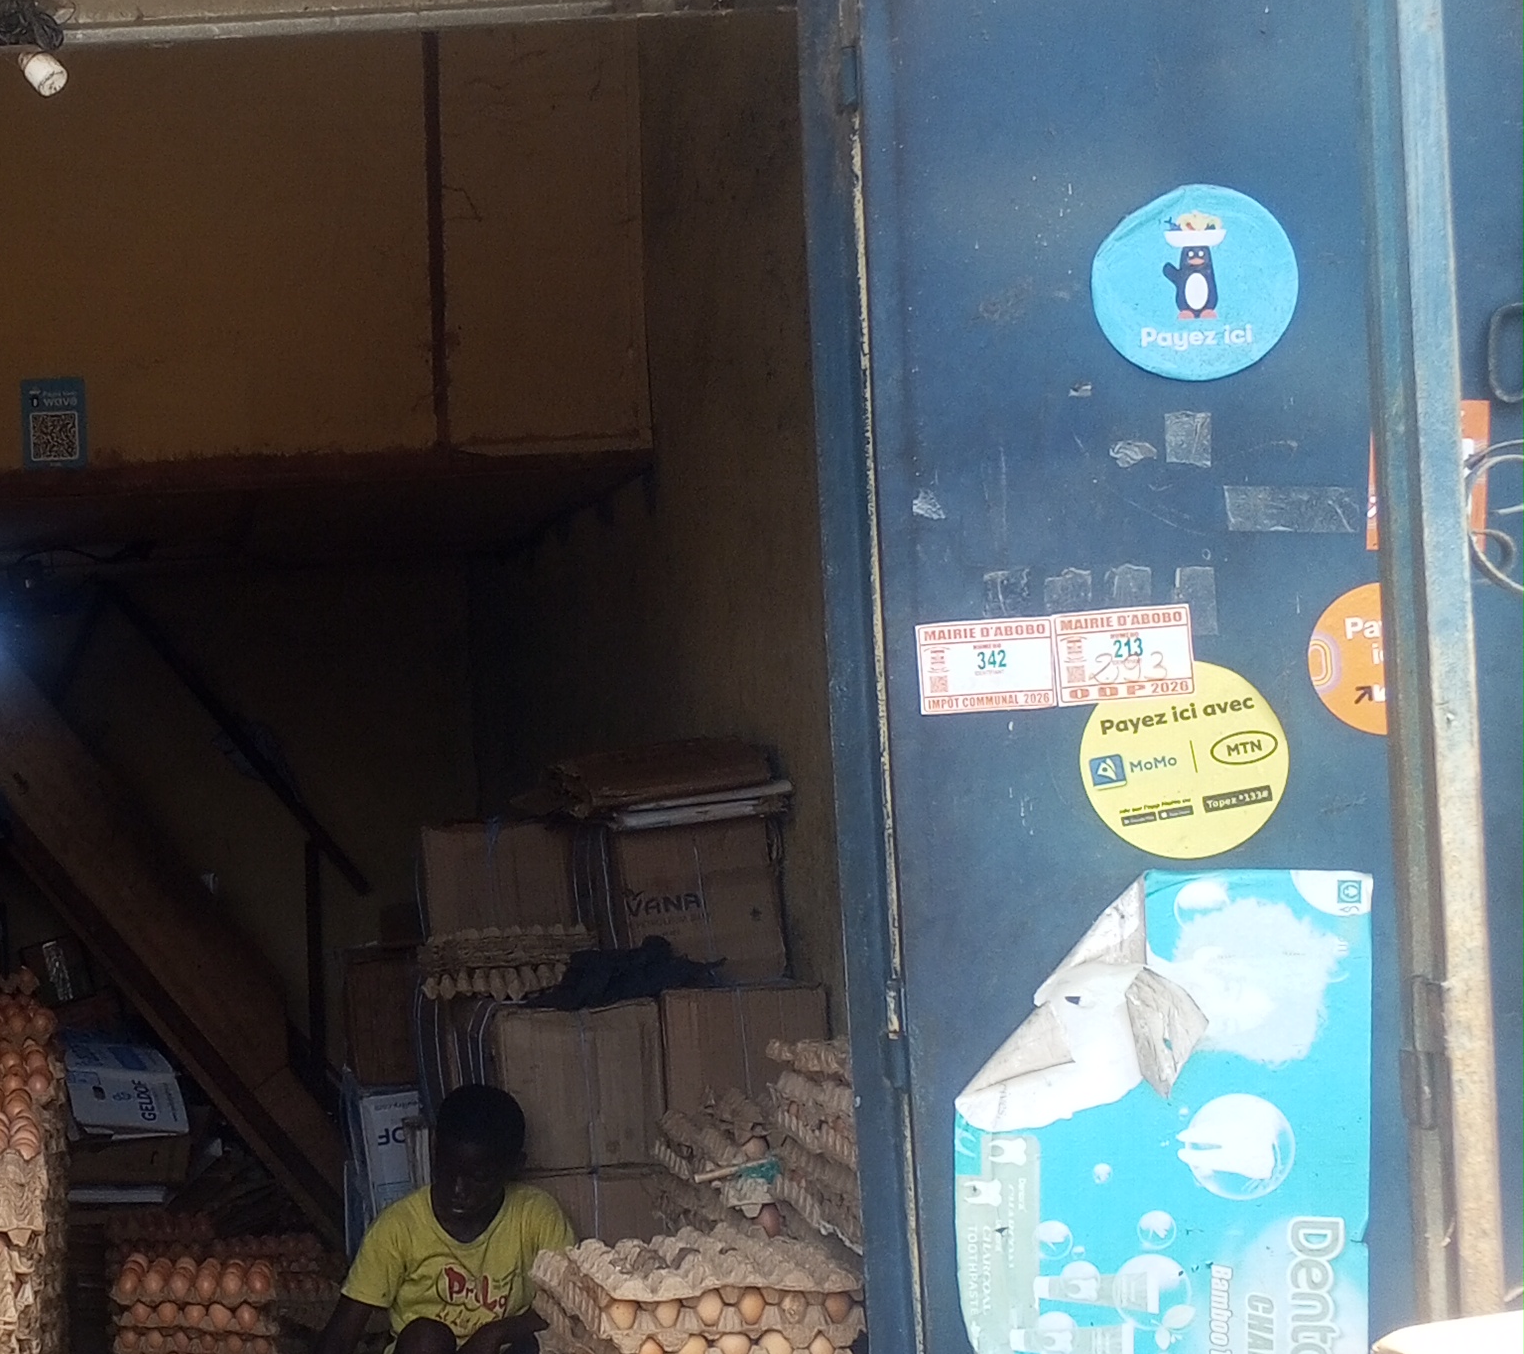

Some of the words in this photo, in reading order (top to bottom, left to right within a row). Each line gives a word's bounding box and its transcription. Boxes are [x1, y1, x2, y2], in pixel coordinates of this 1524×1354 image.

[1141, 326, 1217, 352] Payez
[1223, 324, 1253, 344] ici
[1060, 616, 1114, 631] MAIRIE
[1117, 611, 1183, 627] D'ABOBO
[924, 628, 977, 642] MAIRIE
[980, 623, 1047, 638] D'ABOBO
[1113, 637, 1144, 659] 213
[977, 650, 1008, 670] 342
[962, 694, 1019, 708] COMMUNAL
[1023, 692, 1050, 704] 2026
[1100, 711, 1168, 736] Payez
[1171, 702, 1198, 723] ici
[1202, 696, 1256, 717] avec
[1226, 739, 1263, 757] MTN
[1129, 755, 1177, 773] MoMo
[131, 1079, 157, 1122] GELDOF
[1209, 1265, 1233, 1347] Bamboo
